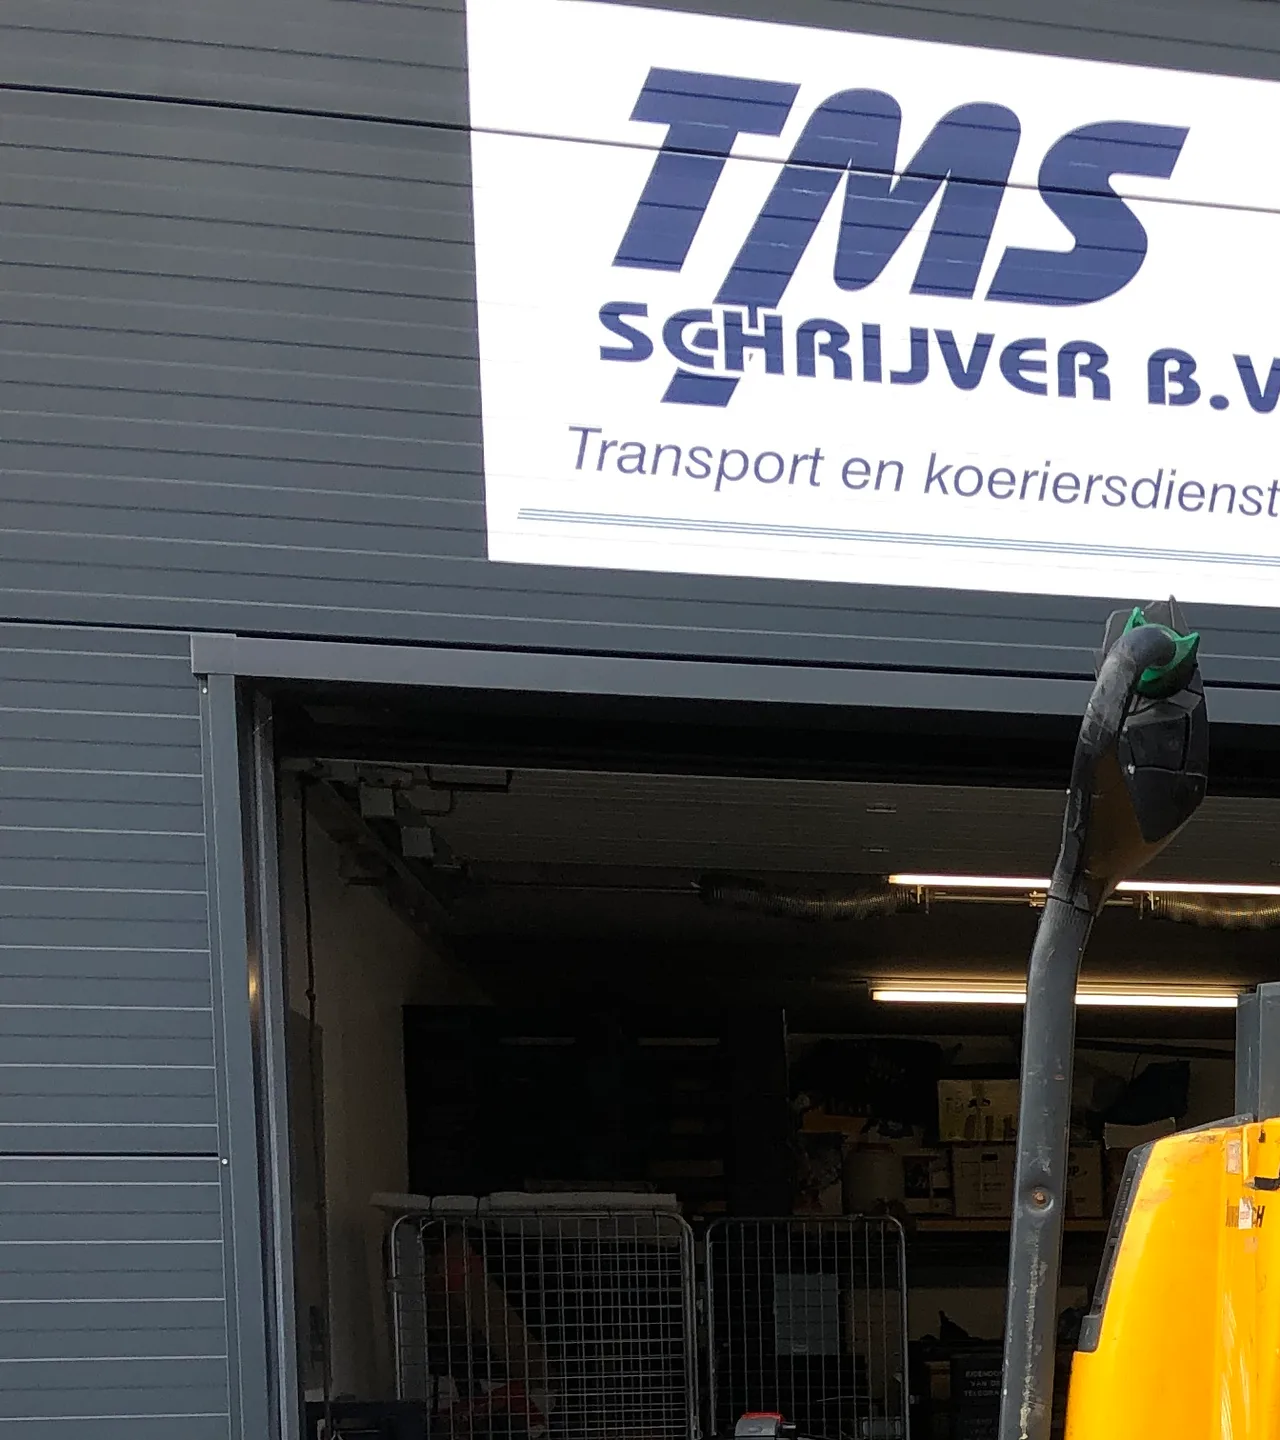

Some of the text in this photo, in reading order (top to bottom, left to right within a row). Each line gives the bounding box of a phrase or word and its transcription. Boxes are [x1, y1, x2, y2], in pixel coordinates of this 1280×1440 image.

[612, 66, 1190, 308] TMS
[599, 299, 1111, 405] SCHRIJVER
[567, 425, 825, 491] Transport
[841, 456, 905, 492] en
